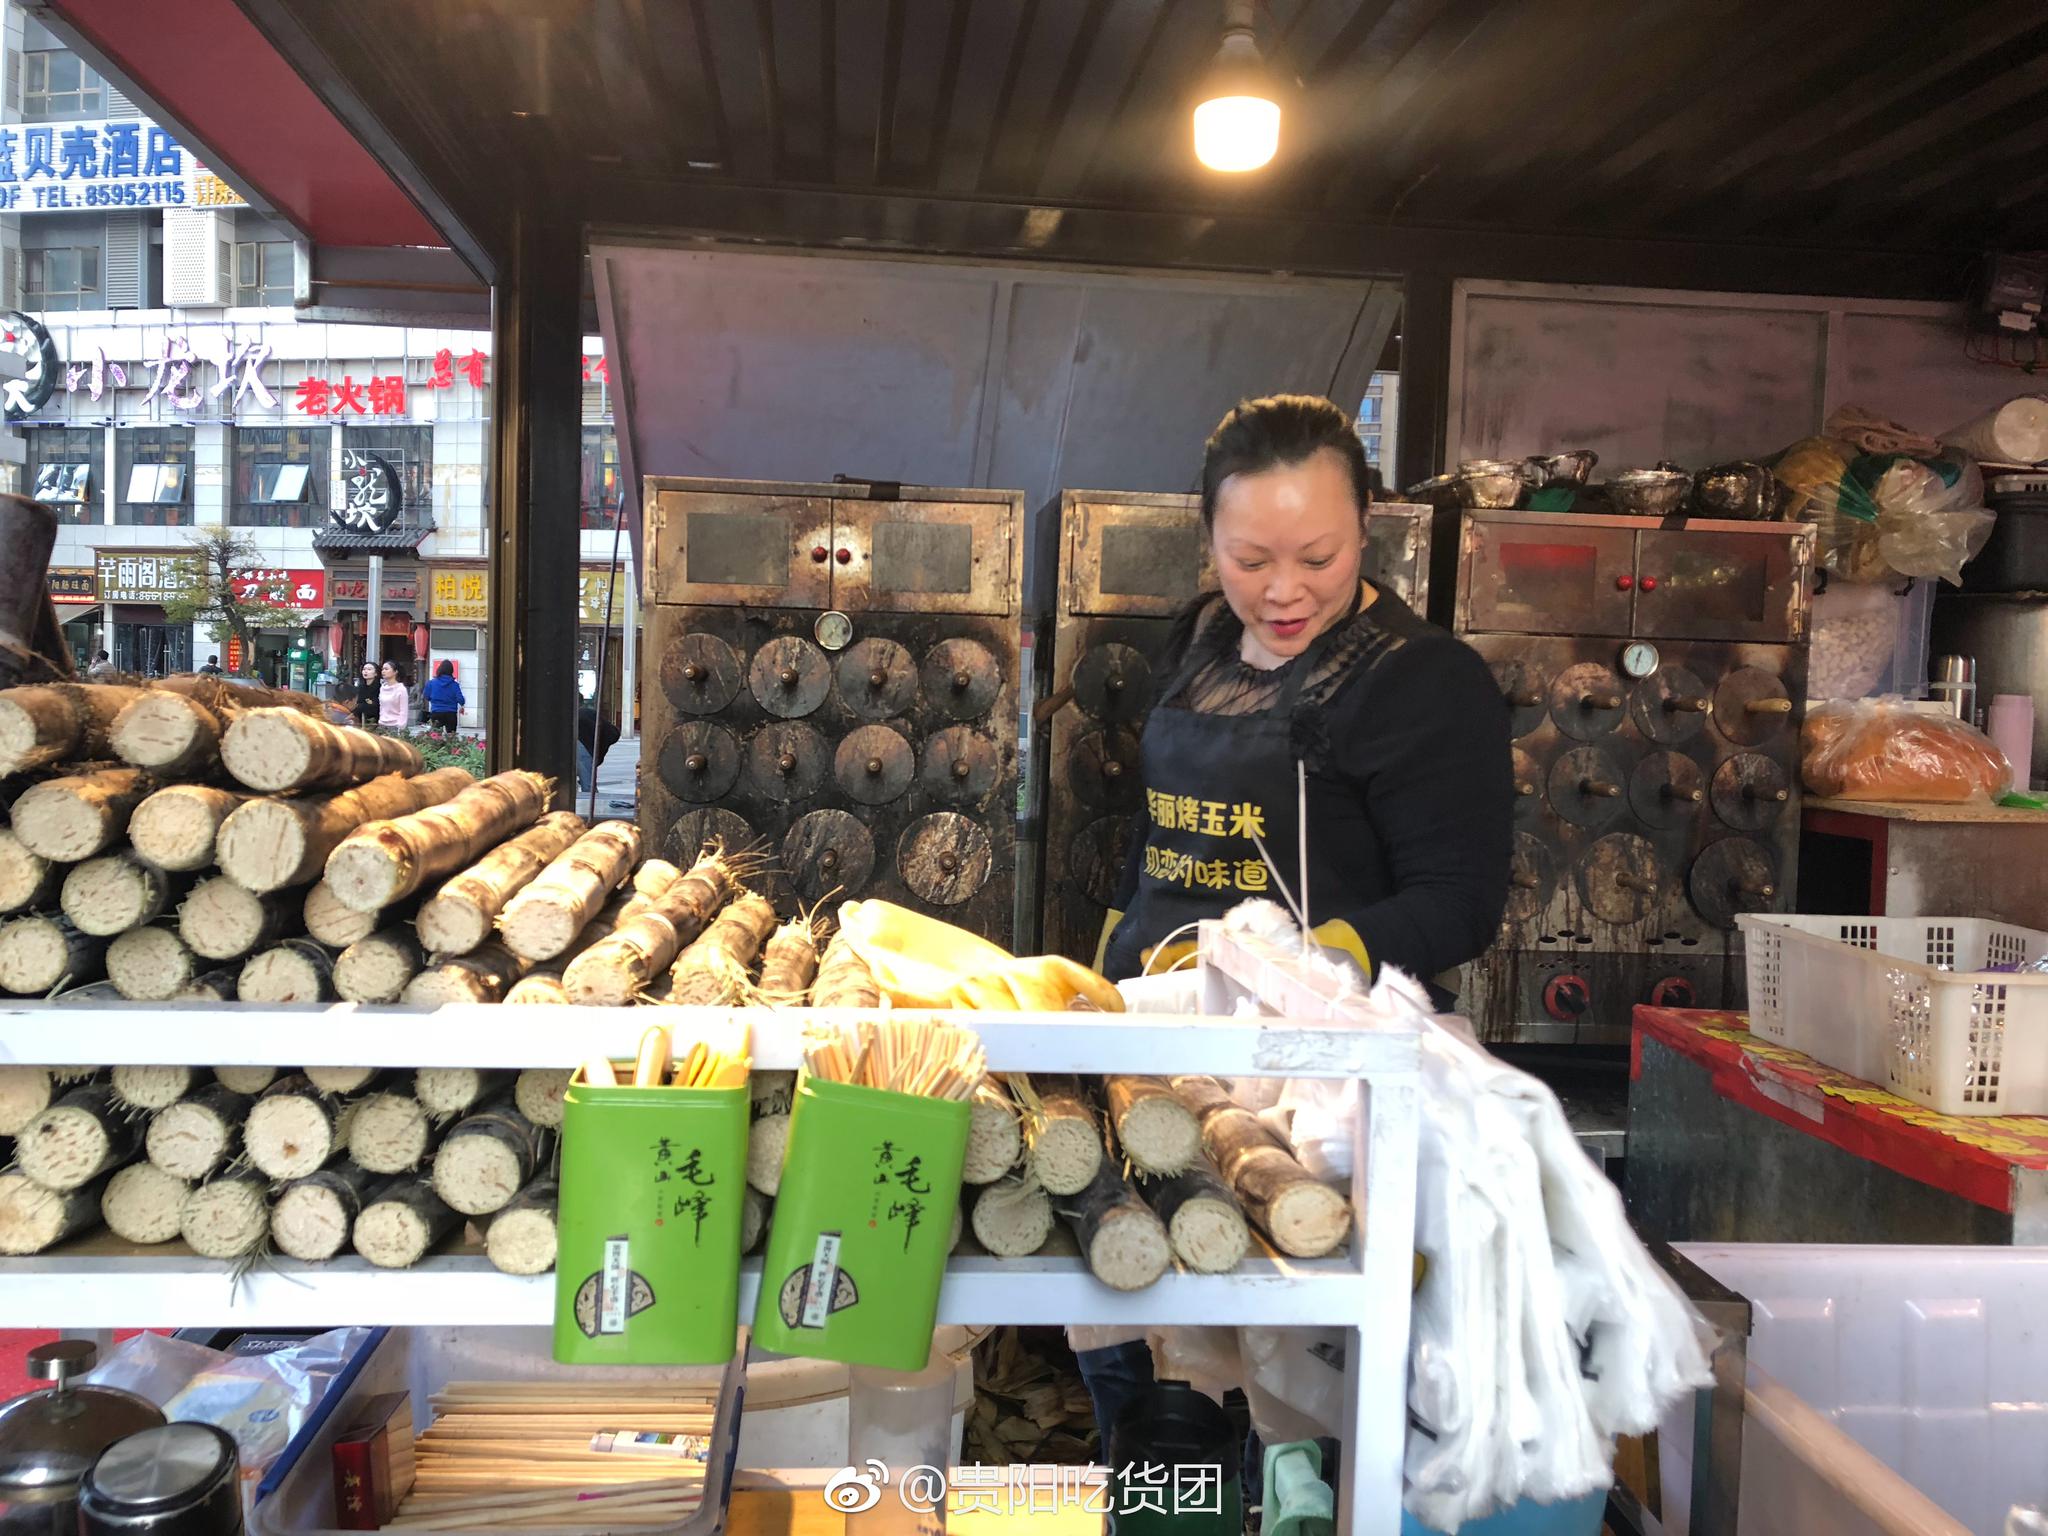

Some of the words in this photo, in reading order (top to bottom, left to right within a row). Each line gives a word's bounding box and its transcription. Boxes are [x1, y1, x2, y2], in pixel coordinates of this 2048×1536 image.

[66, 334, 280, 409] 小龙坎
[296, 376, 406, 415] 老火锅
[47, 579, 90, 591] 阳肠旺面
[435, 575, 483, 601] 柏悦
